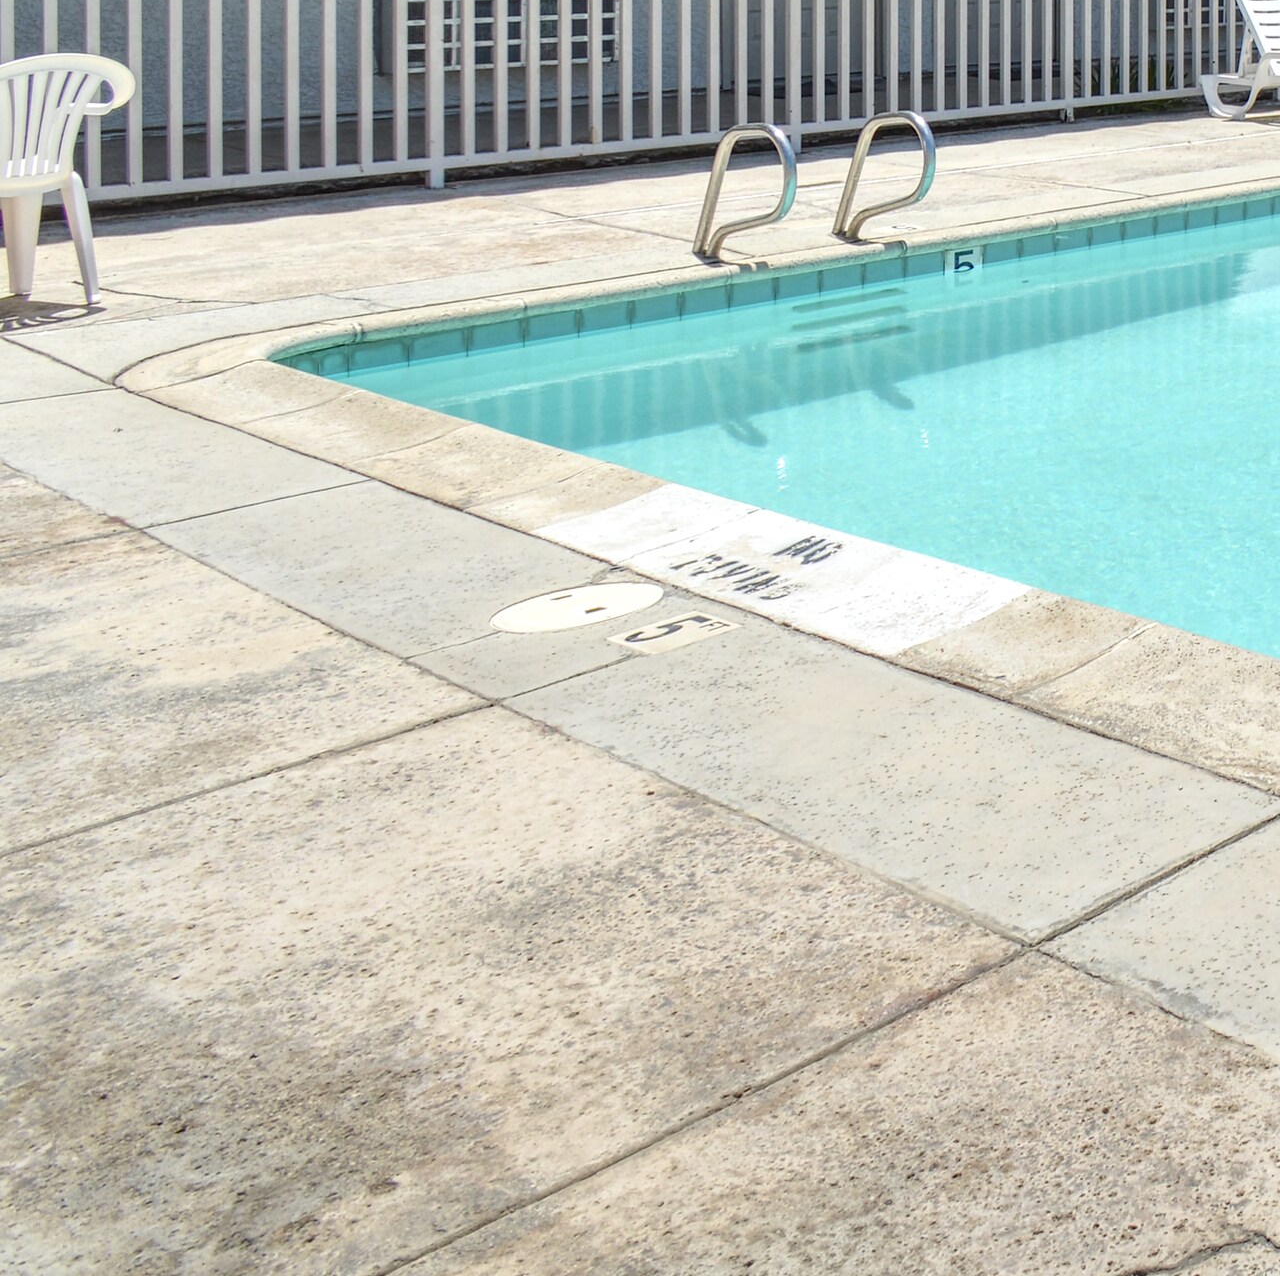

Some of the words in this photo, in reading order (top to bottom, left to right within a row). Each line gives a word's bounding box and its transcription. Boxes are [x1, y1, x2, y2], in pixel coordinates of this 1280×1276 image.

[953, 248, 975, 274] 5
[772, 534, 844, 566] NO
[624, 614, 712, 644] 5
[699, 620, 732, 633] FT
